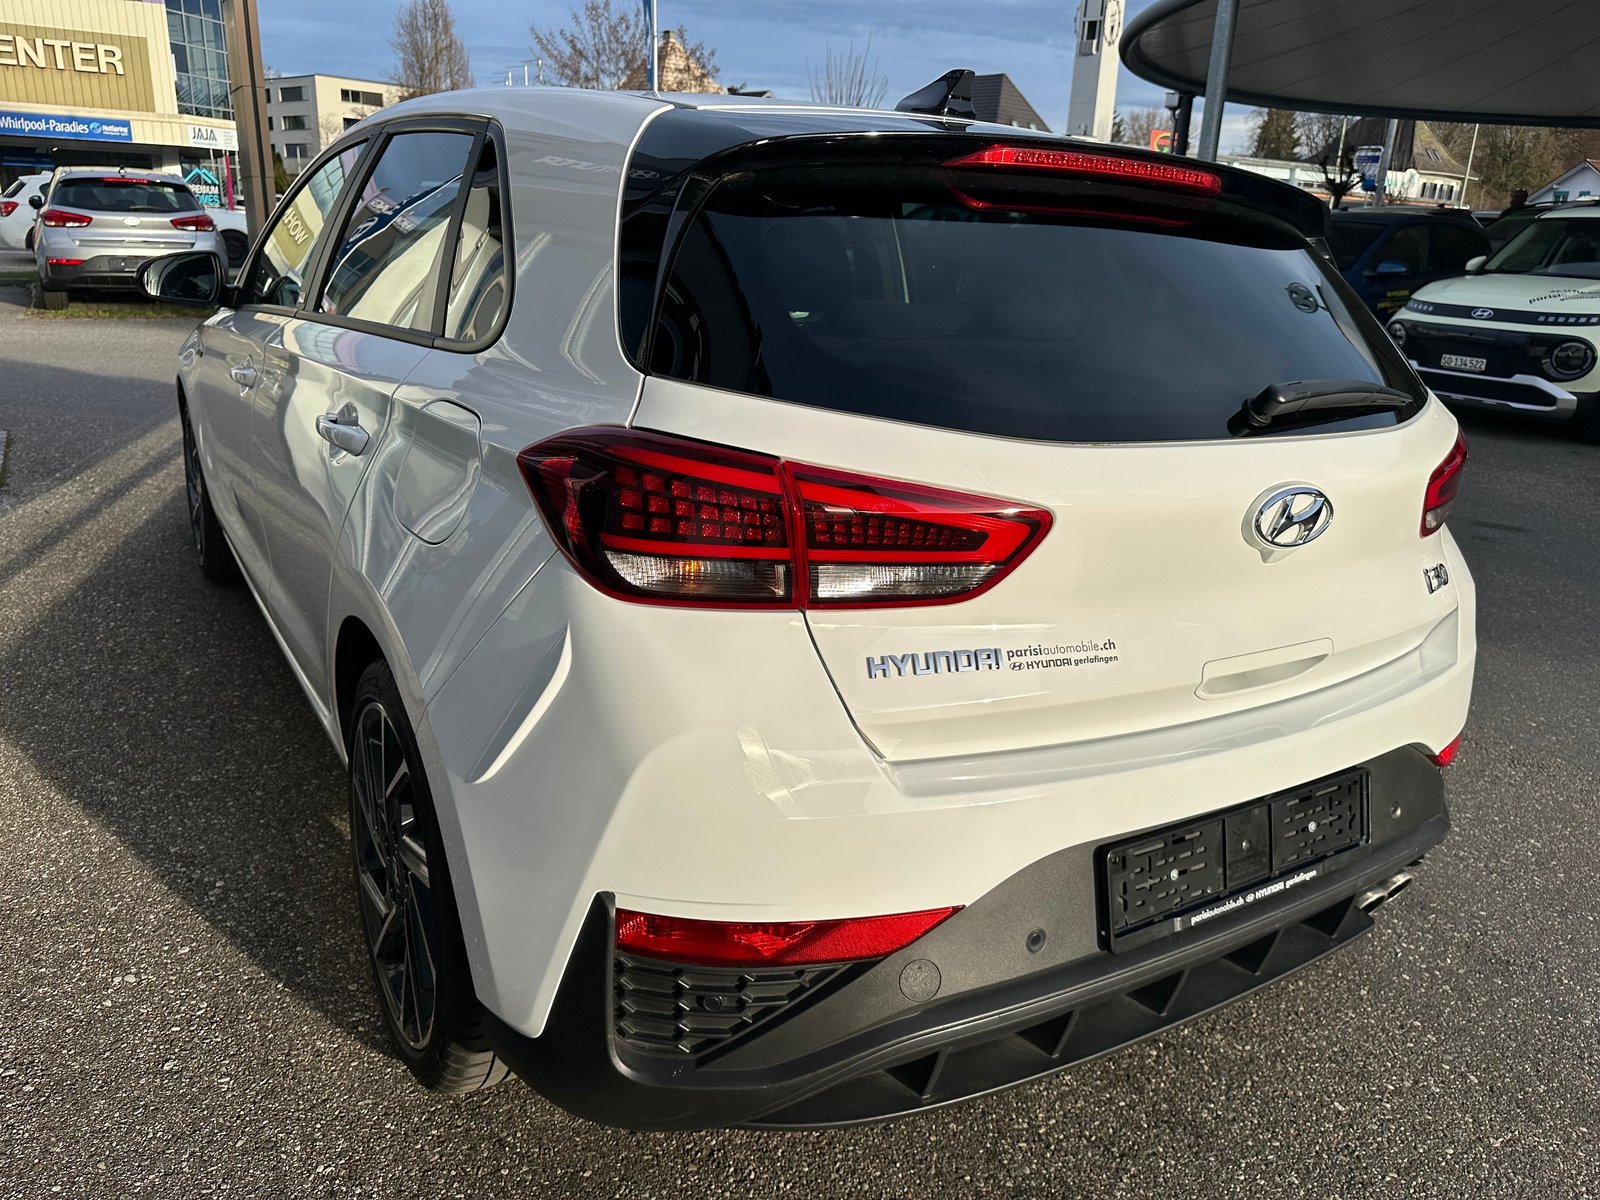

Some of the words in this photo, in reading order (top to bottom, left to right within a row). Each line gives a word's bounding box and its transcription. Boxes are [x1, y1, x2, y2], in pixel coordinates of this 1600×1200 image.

[0, 35, 124, 75] ENTER
[0, 116, 89, 133] Whirlpool-Paradies
[193, 127, 217, 142] JAJA
[1006, 639, 1116, 661] parisiautomobile.ch
[865, 647, 1004, 679] HYUNDAI
[1026, 658, 1072, 670] HYUNDAI
[1073, 654, 1118, 667] gerlafingen
[1255, 881, 1284, 899] HYUNDAI
